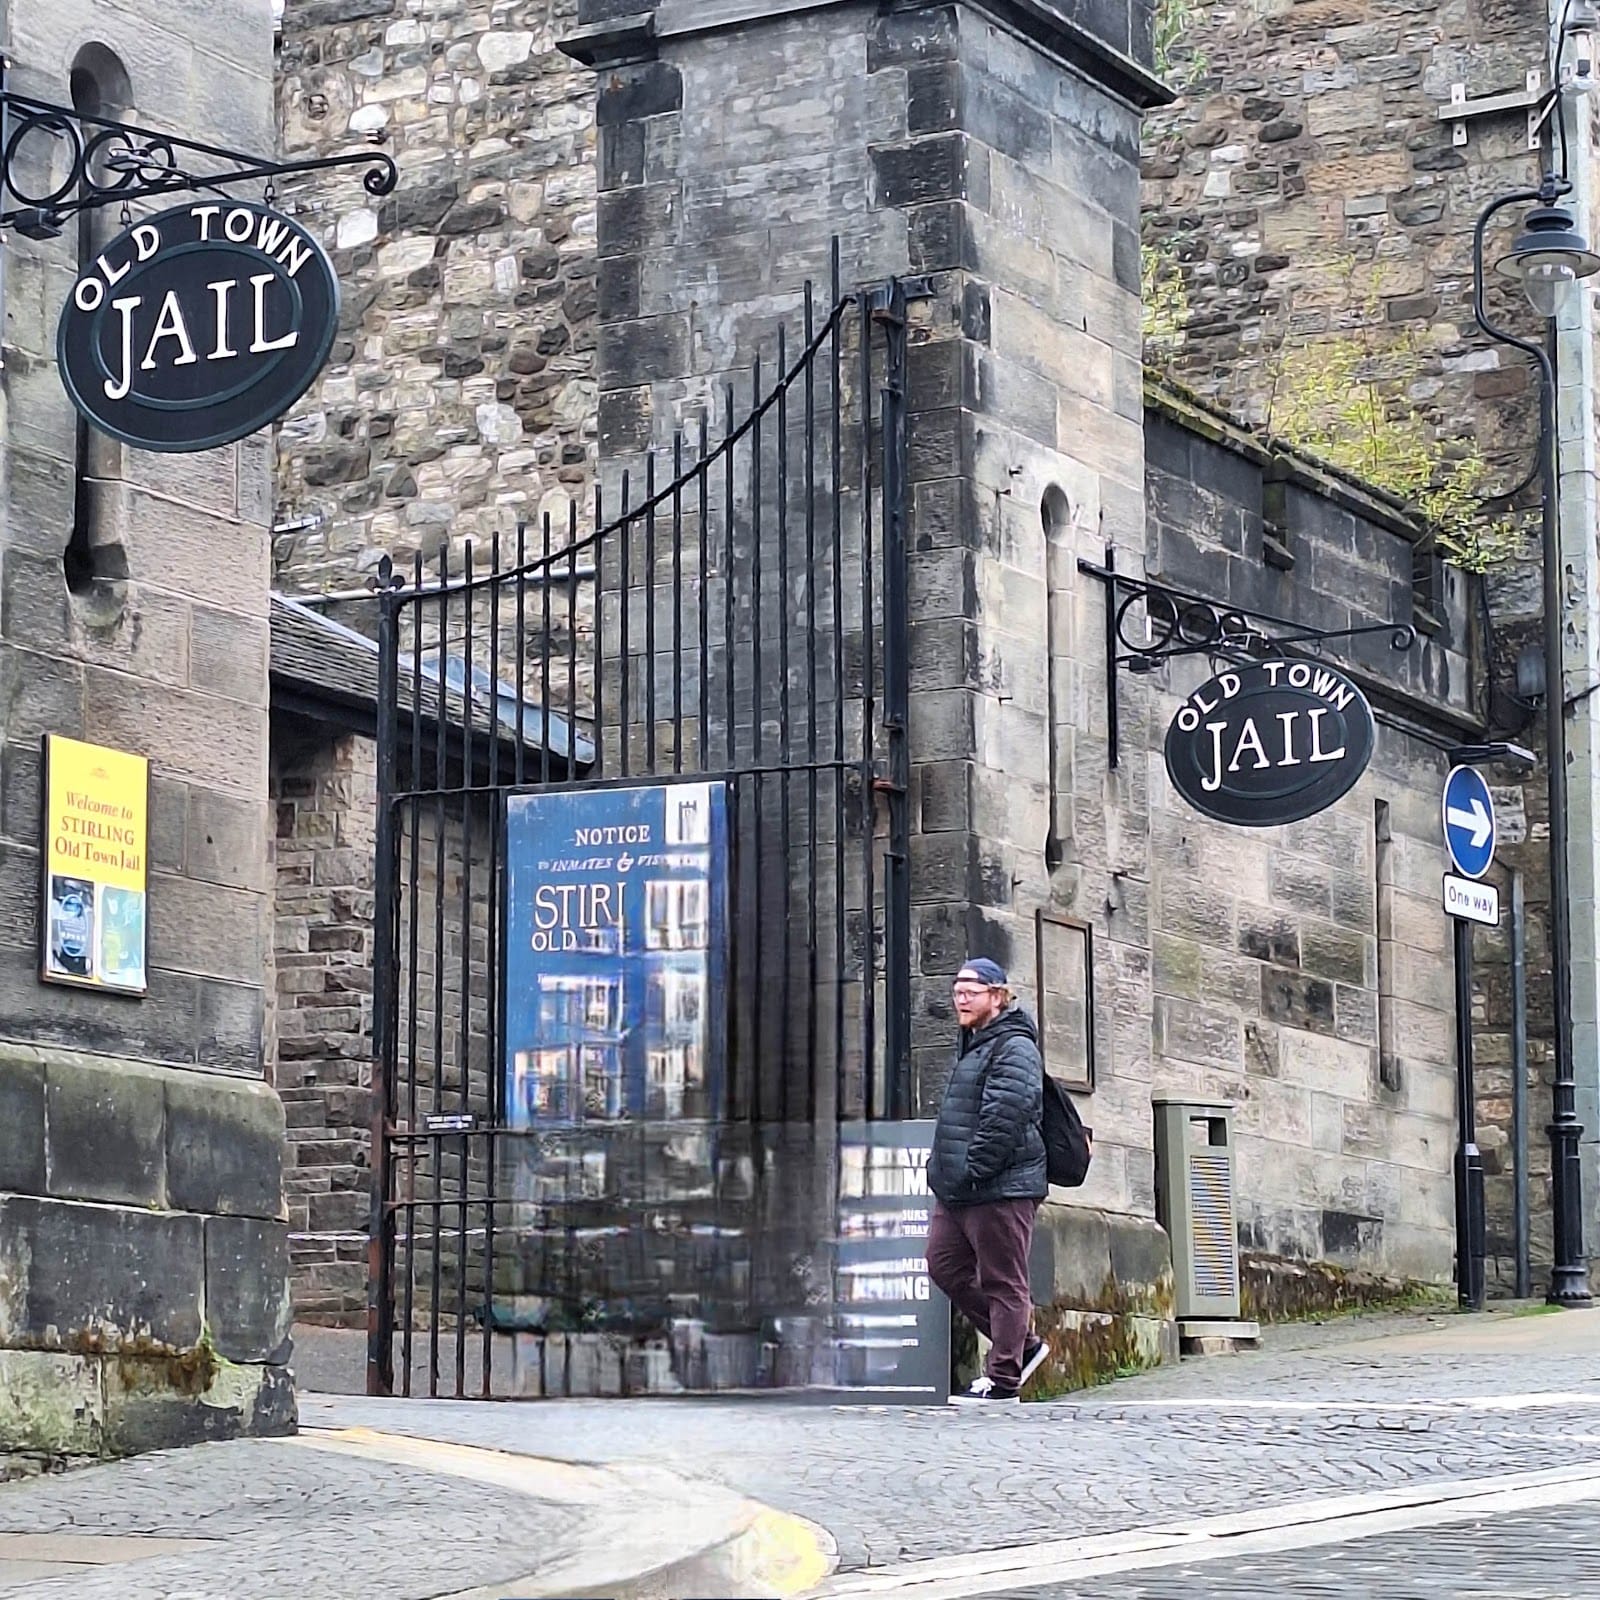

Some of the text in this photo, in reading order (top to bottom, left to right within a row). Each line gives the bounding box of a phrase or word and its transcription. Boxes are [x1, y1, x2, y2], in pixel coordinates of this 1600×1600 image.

[75, 206, 314, 311] OLD TOWN
[104, 274, 298, 400] JAIL
[1177, 662, 1355, 731] OLD TOWN
[1201, 708, 1345, 791] JAIL
[67, 791, 133, 820] Welcome to
[61, 815, 135, 846] STIRLING
[574, 825, 650, 847] NOTICE
[55, 836, 140, 871] Old Town Jail
[551, 857, 613, 873] INMATES
[616, 851, 635, 873] &
[1449, 885, 1493, 916] One way
[531, 929, 577, 951] OLD
